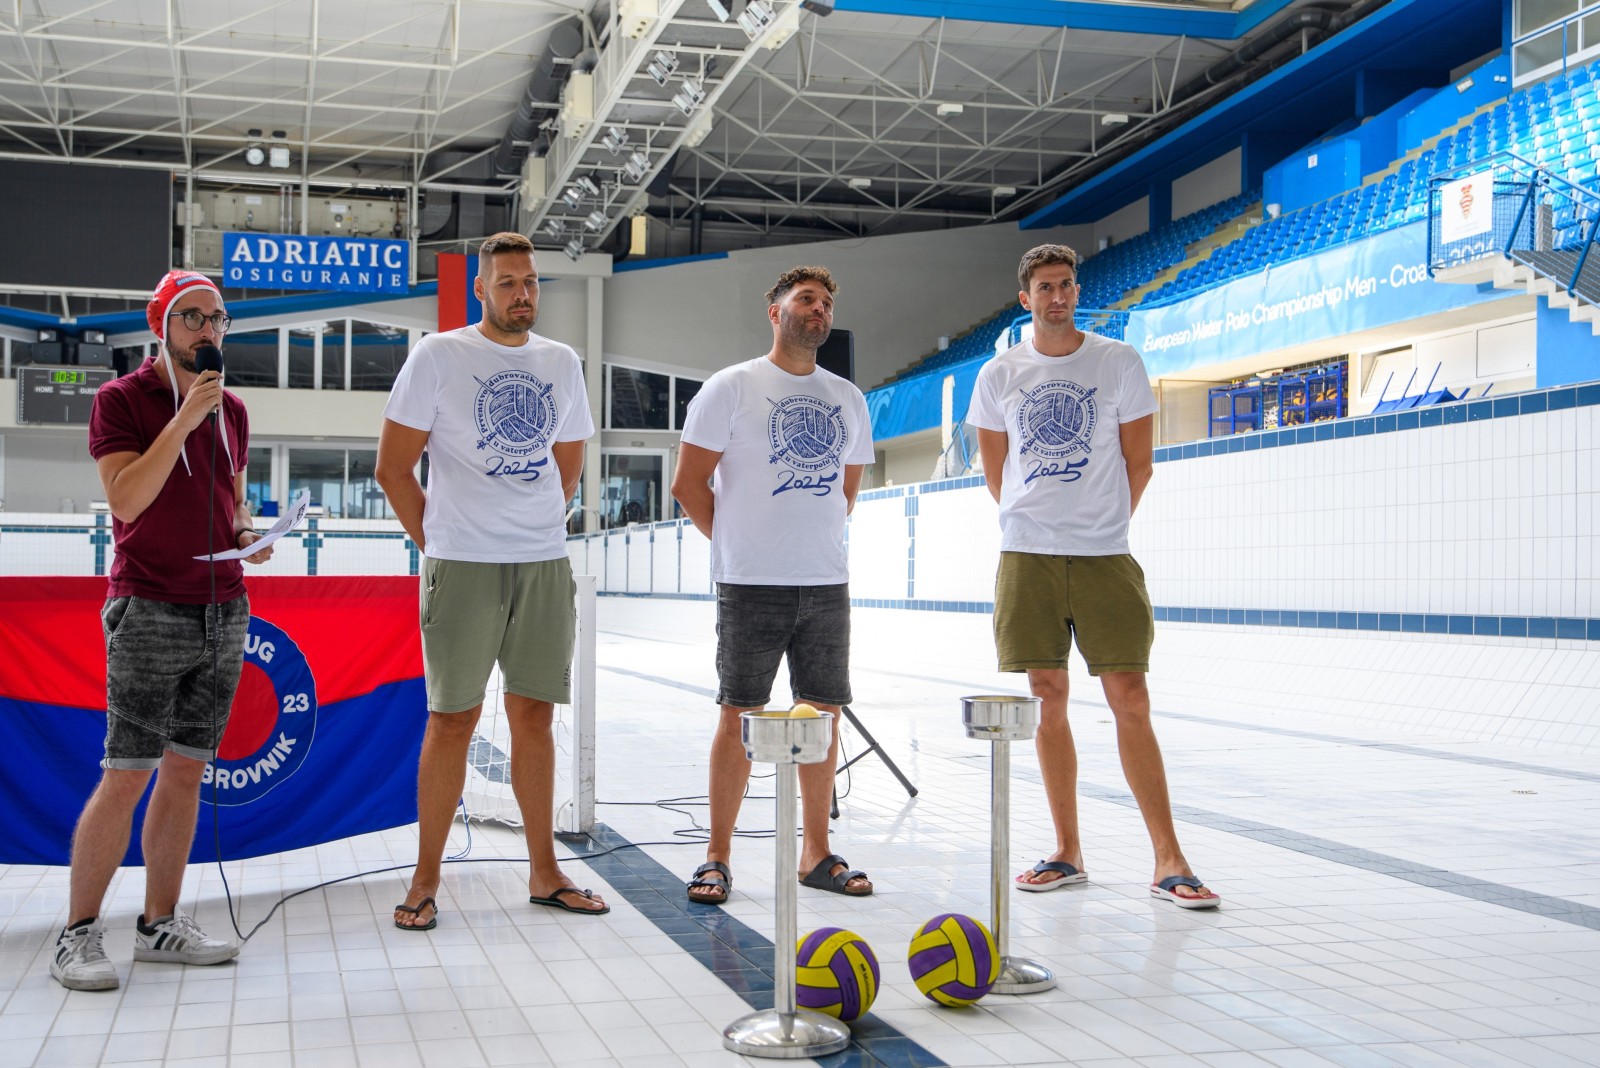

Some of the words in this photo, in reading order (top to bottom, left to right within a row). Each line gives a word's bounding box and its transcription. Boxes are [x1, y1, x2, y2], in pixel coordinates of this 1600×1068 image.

[231, 237, 402, 269] ADRIATIC
[230, 266, 401, 288] OSIGURANJE
[1143, 328, 1191, 353] European
[1192, 318, 1224, 341] Water
[1225, 308, 1250, 333] Polo
[1252, 282, 1342, 325] Championship
[1345, 275, 1376, 301] Men
[35, 386, 55, 394] HOME
[79, 387, 99, 395] GUES
[500, 442, 541, 455] vaterpolu
[1040, 444, 1078, 458] vaterpolu
[485, 455, 549, 482] 2025
[792, 458, 831, 471] vaterpolu
[1024, 457, 1089, 485] 2025
[771, 470, 839, 497] 2025
[244, 633, 276, 664] UG
[283, 693, 310, 713] 23
[201, 731, 297, 790] BROVNIK
